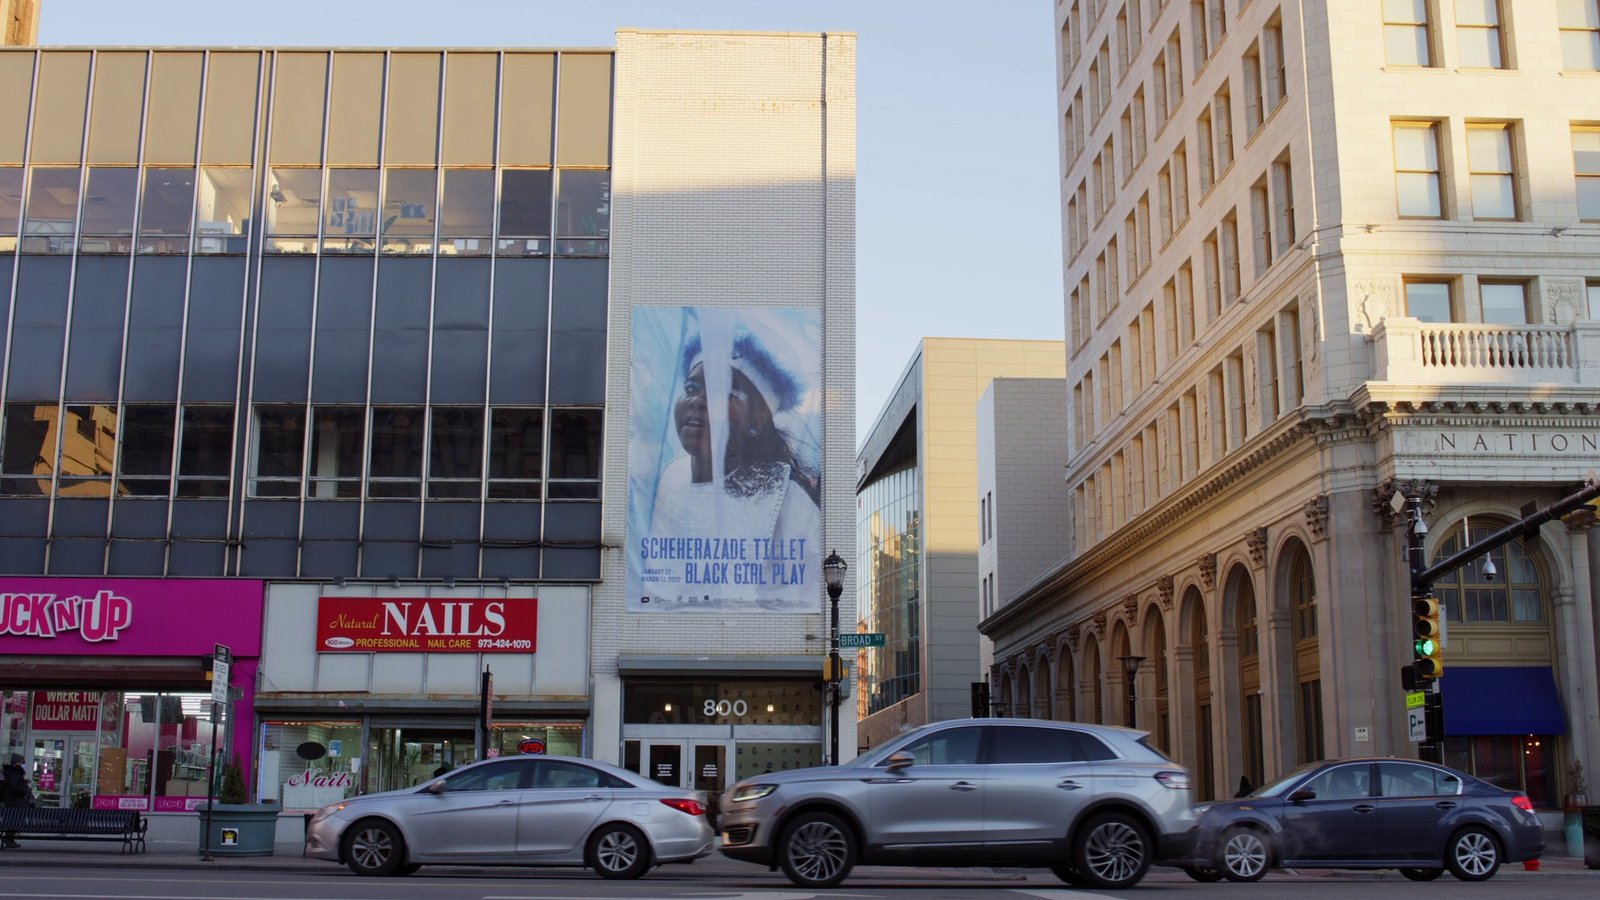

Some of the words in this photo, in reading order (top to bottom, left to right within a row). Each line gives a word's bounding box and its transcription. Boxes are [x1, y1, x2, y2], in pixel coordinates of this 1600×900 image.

[641, 537, 747, 560] SCHEHERAZADE
[753, 538, 806, 560] TILLET
[685, 563, 728, 584] BLACK
[734, 563, 766, 585] GIRL
[772, 563, 806, 585] PLAY
[329, 614, 379, 629] Natural
[381, 602, 505, 636] NAILS
[356, 638, 419, 648] PROFESSIONAL
[427, 639, 447, 648] NAIL
[449, 639, 471, 648] CARE
[477, 639, 531, 649] 973-424-1070
[841, 635, 871, 646] BROAD
[35, 704, 70, 721] DOLLAR
[703, 699, 748, 716] 800
[288, 768, 352, 788] Nails
